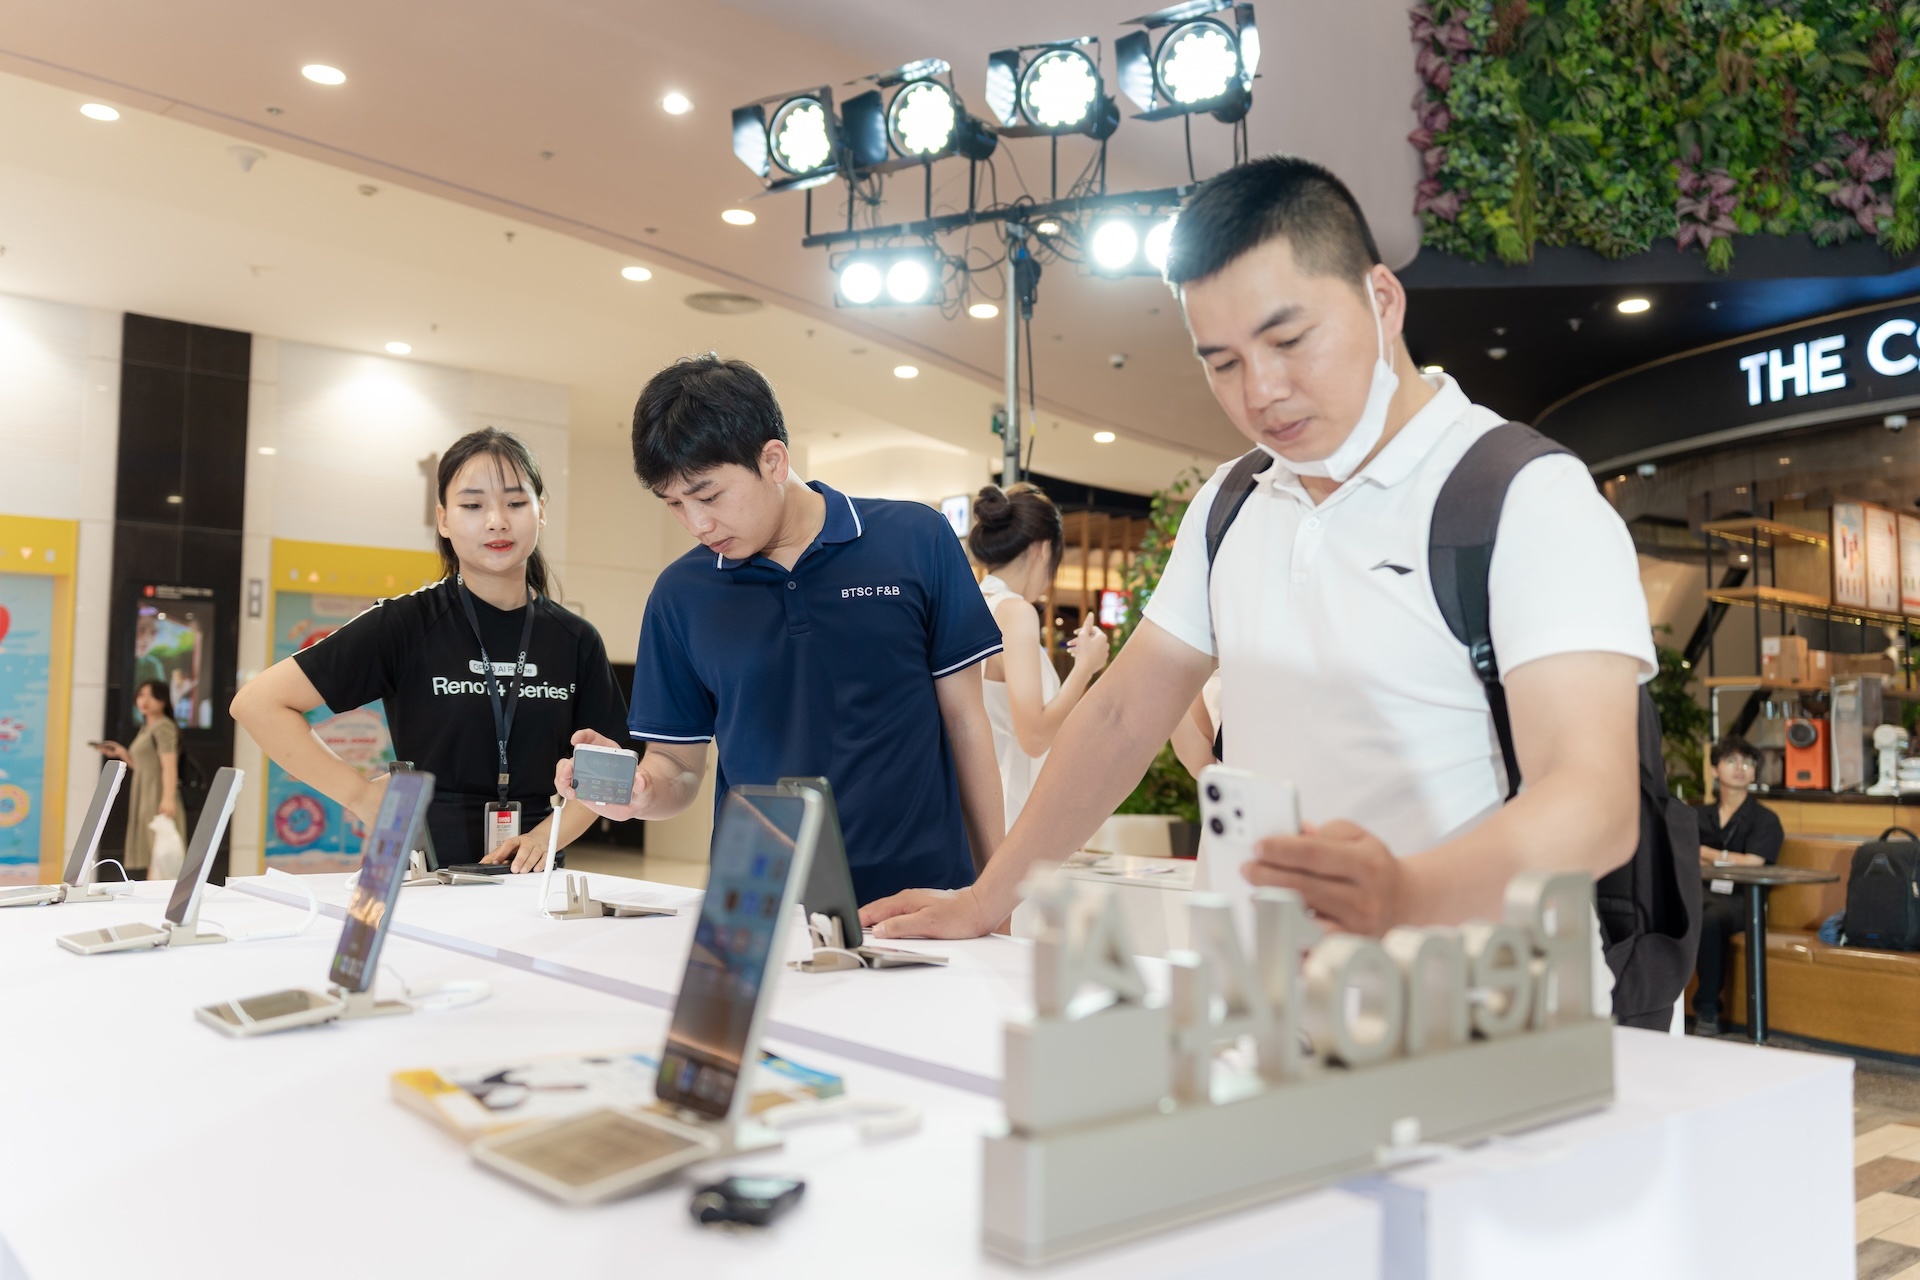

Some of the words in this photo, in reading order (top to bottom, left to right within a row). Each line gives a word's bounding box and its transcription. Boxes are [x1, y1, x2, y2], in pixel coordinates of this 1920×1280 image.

[1739, 334, 1846, 406] THE
[1866, 318, 1920, 377] C
[841, 586, 873, 598] BTSC
[876, 585, 901, 596] F&B
[473, 663, 496, 672] OPO
